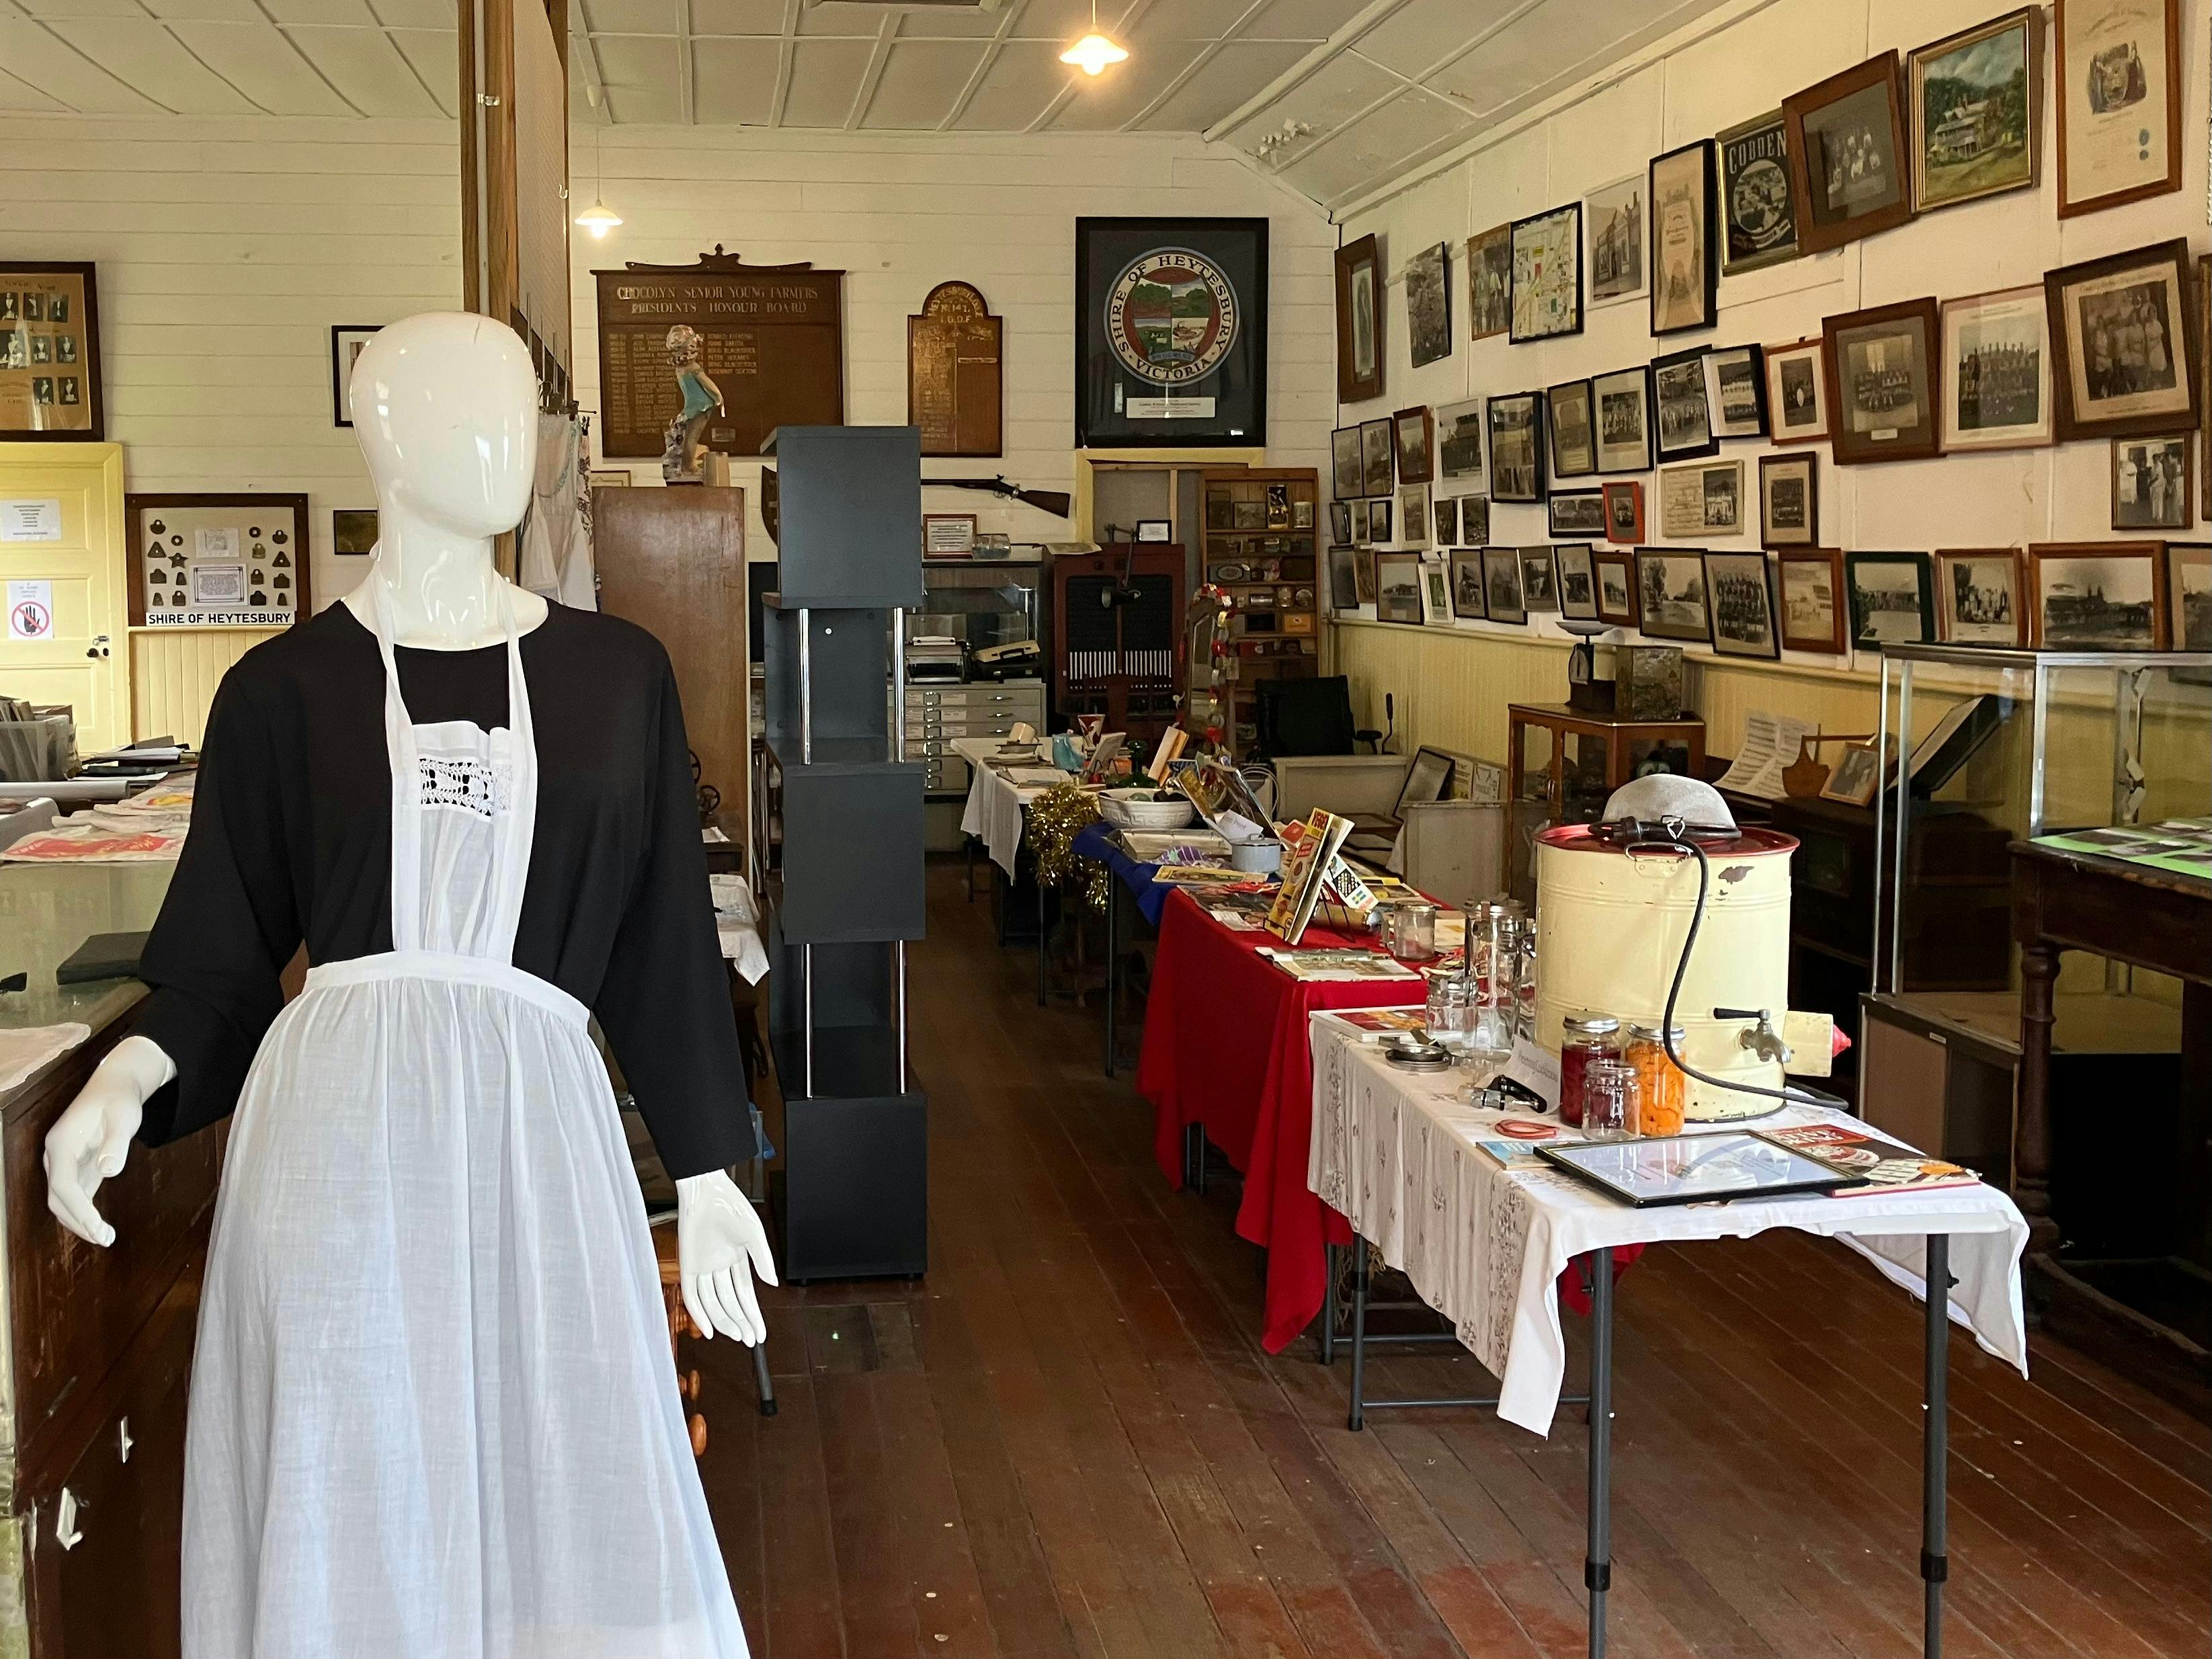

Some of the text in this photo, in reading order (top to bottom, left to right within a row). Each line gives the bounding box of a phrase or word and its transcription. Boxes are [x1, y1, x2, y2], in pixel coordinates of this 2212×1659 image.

[684, 286, 723, 299] SENIOR
[729, 286, 765, 299] YOUNG
[770, 286, 818, 299] FARMERS
[631, 302, 807, 314] PRESIDENTS HONOUR BOARD
[1111, 255, 1231, 353] SHIRE OF HEYTESBURY
[1135, 359, 1213, 380] VICTORIA
[149, 612, 291, 624] SHIRE OF HEYTESBURY
